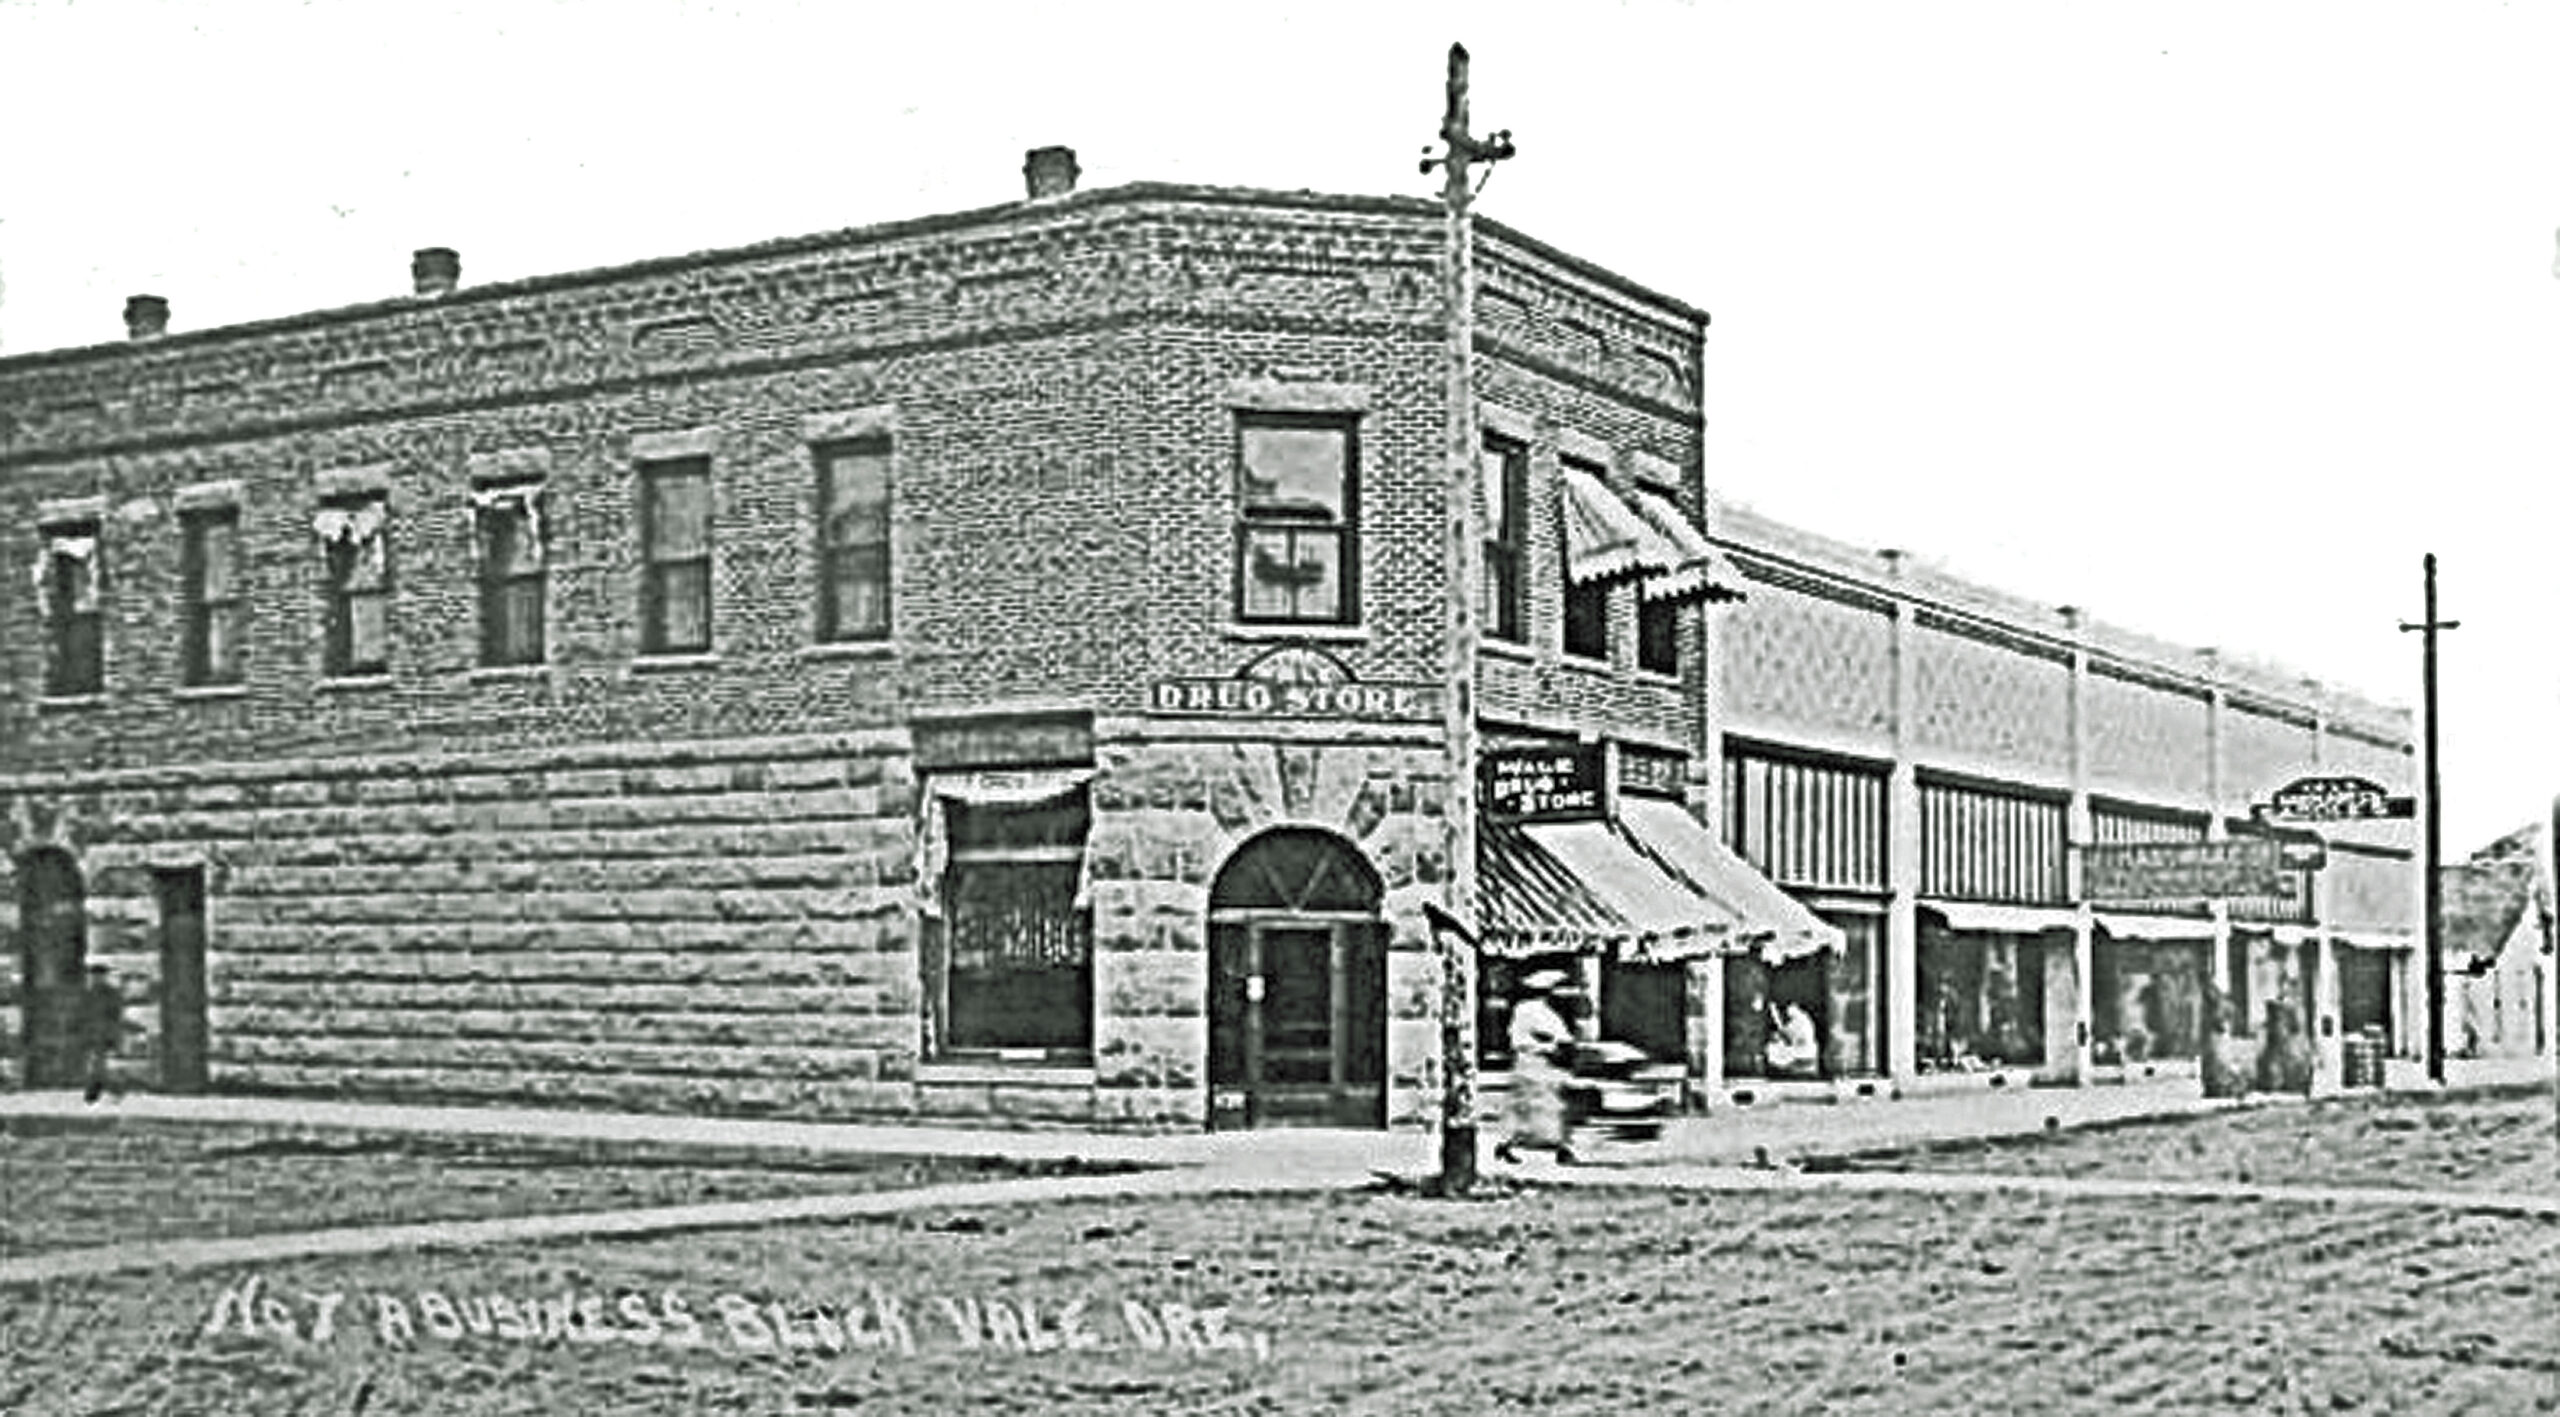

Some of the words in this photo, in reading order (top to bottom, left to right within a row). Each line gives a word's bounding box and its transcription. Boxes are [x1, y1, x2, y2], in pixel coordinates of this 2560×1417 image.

[1158, 682, 1273, 713] DRUG
[1283, 685, 1420, 717] STORE
[1519, 789, 1596, 814] STORE
